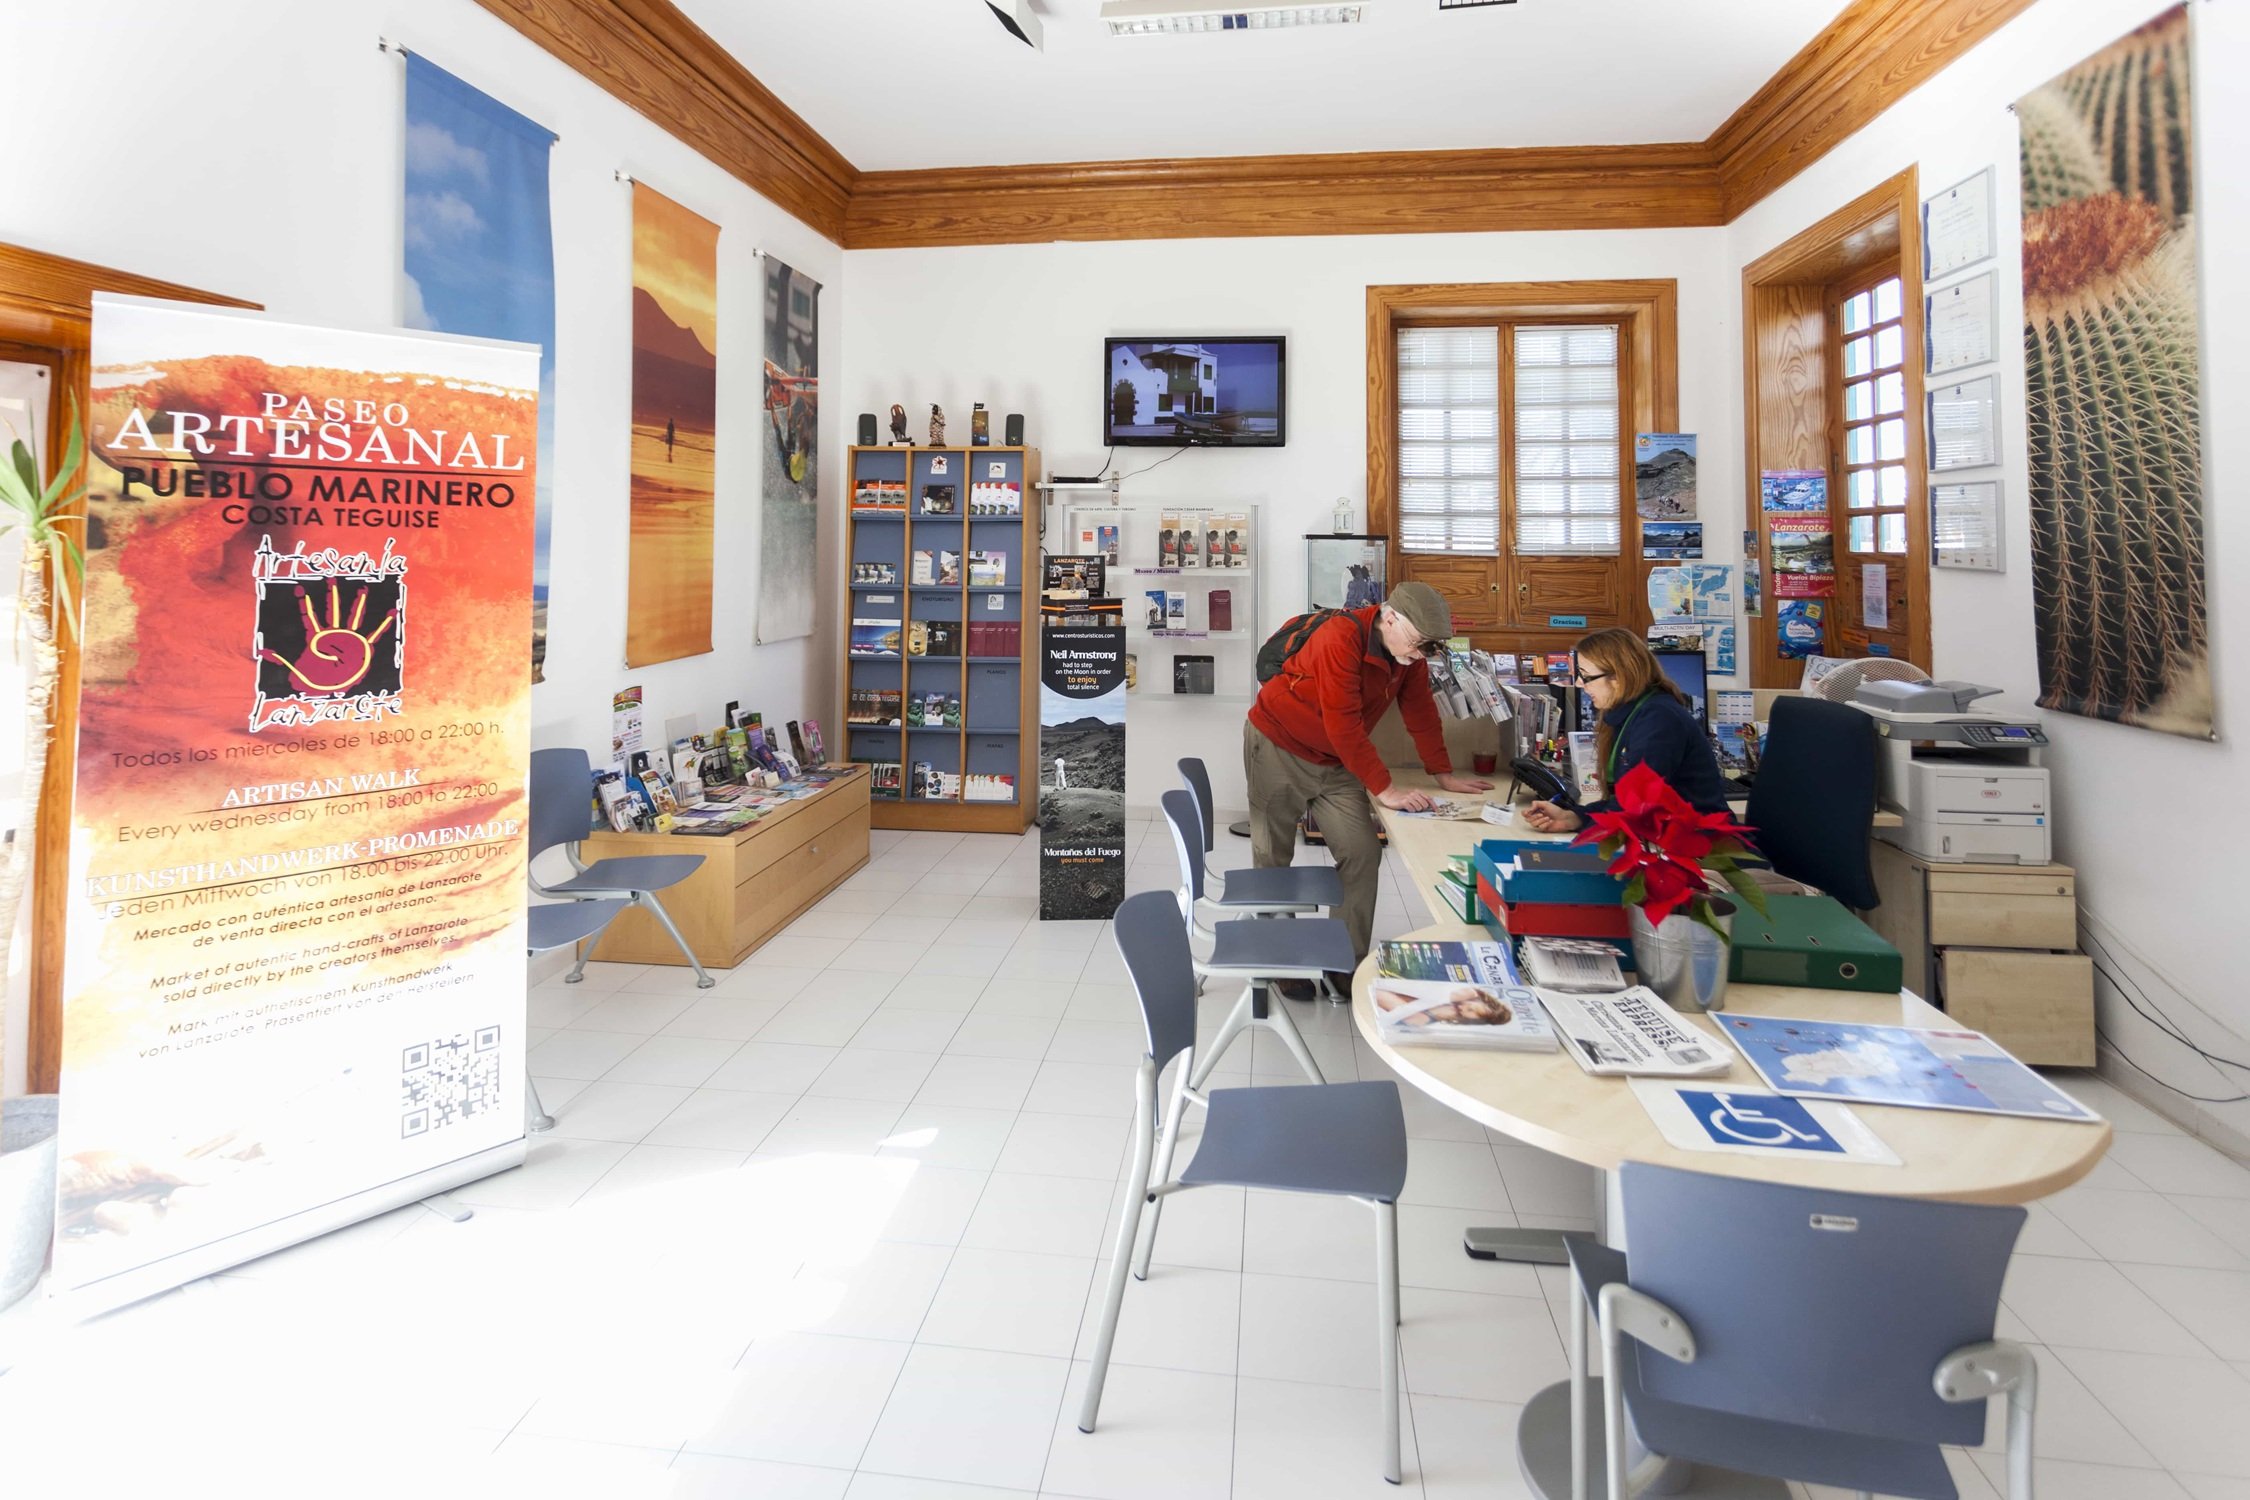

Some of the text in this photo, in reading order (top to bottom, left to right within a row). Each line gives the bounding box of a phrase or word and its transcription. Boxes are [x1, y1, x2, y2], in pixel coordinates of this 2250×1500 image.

[261, 392, 409, 427] PASEO
[105, 407, 525, 471] ARTESANAL
[121, 466, 515, 508] PUEBLO MARINERO
[222, 504, 440, 529] COSTA TEGUISE
[1775, 523, 1825, 532] Lanzarote
[1774, 570, 1782, 596] Tandem
[1050, 650, 1117, 661] Neil Armstrong
[1077, 676, 1097, 684] enjoy
[112, 721, 504, 769] Todos los miercoles de 18:00 a 22:00 h.
[221, 768, 421, 808] ARTISAN WALK
[118, 782, 499, 842] Every wednesday from 18:00 to 22:00
[86, 819, 520, 898] KUNSTHANDWERK-PROMENADE
[1044, 848, 1121, 857] Montañas del Fuego
[98, 844, 509, 921] Jeden Mittwoch von 18.00 bis 22.00 Uhr.
[133, 871, 483, 942] Mercado con auténtica artesanía de Lanzarote
[192, 894, 437, 948] de venta directa con el artesano.
[150, 917, 469, 990] Market of autentic hand-crafts of Lanzarote
[163, 934, 457, 1004] sold directly by the creators themselves.
[168, 1019, 208, 1037] Mark
[351, 962, 454, 995] Kunsthandwerk
[1626, 998, 1686, 1044] TEGUISE
[139, 1045, 169, 1058] von
